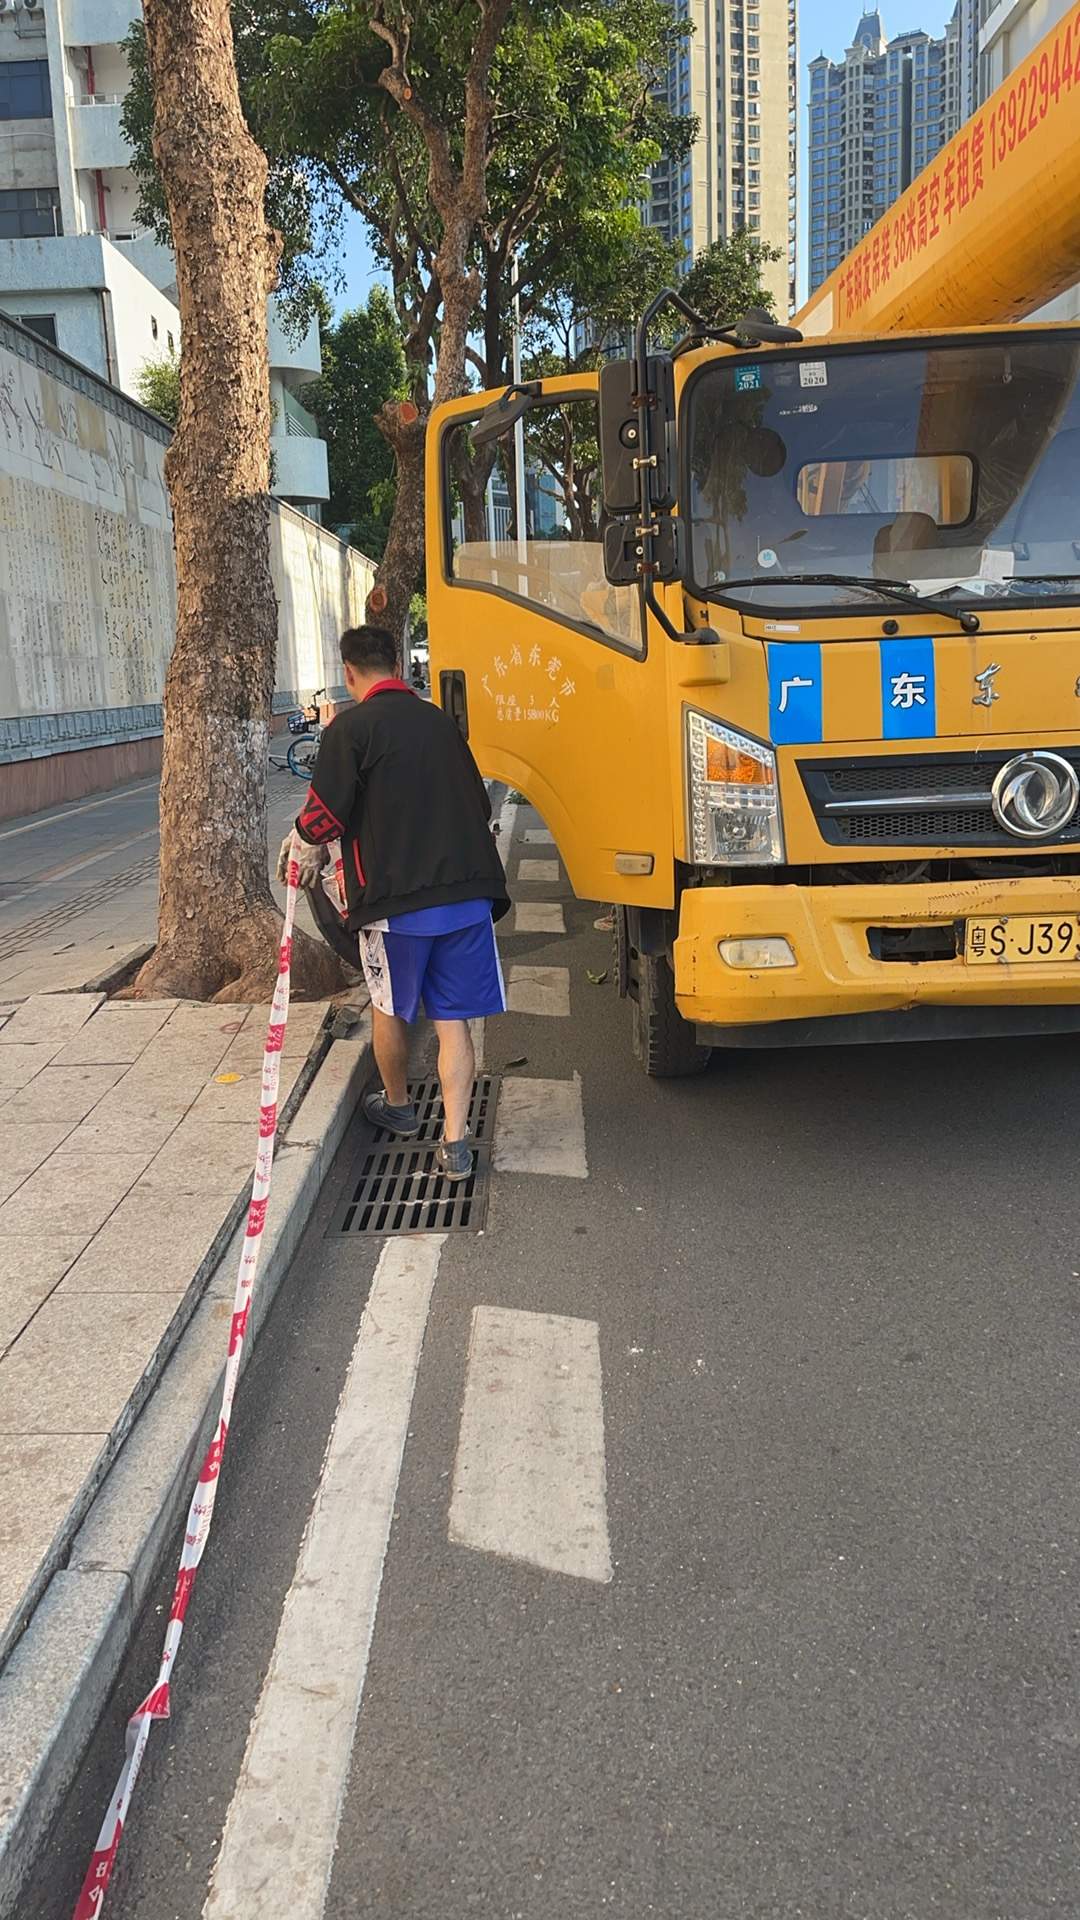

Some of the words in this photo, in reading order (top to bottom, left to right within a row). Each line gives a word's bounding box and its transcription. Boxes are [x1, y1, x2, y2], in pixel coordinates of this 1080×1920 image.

[738, 380, 760, 390] 2021
[803, 377, 825, 385] 2020
[778, 676, 813, 713] 广
[890, 672, 927, 709] 东
